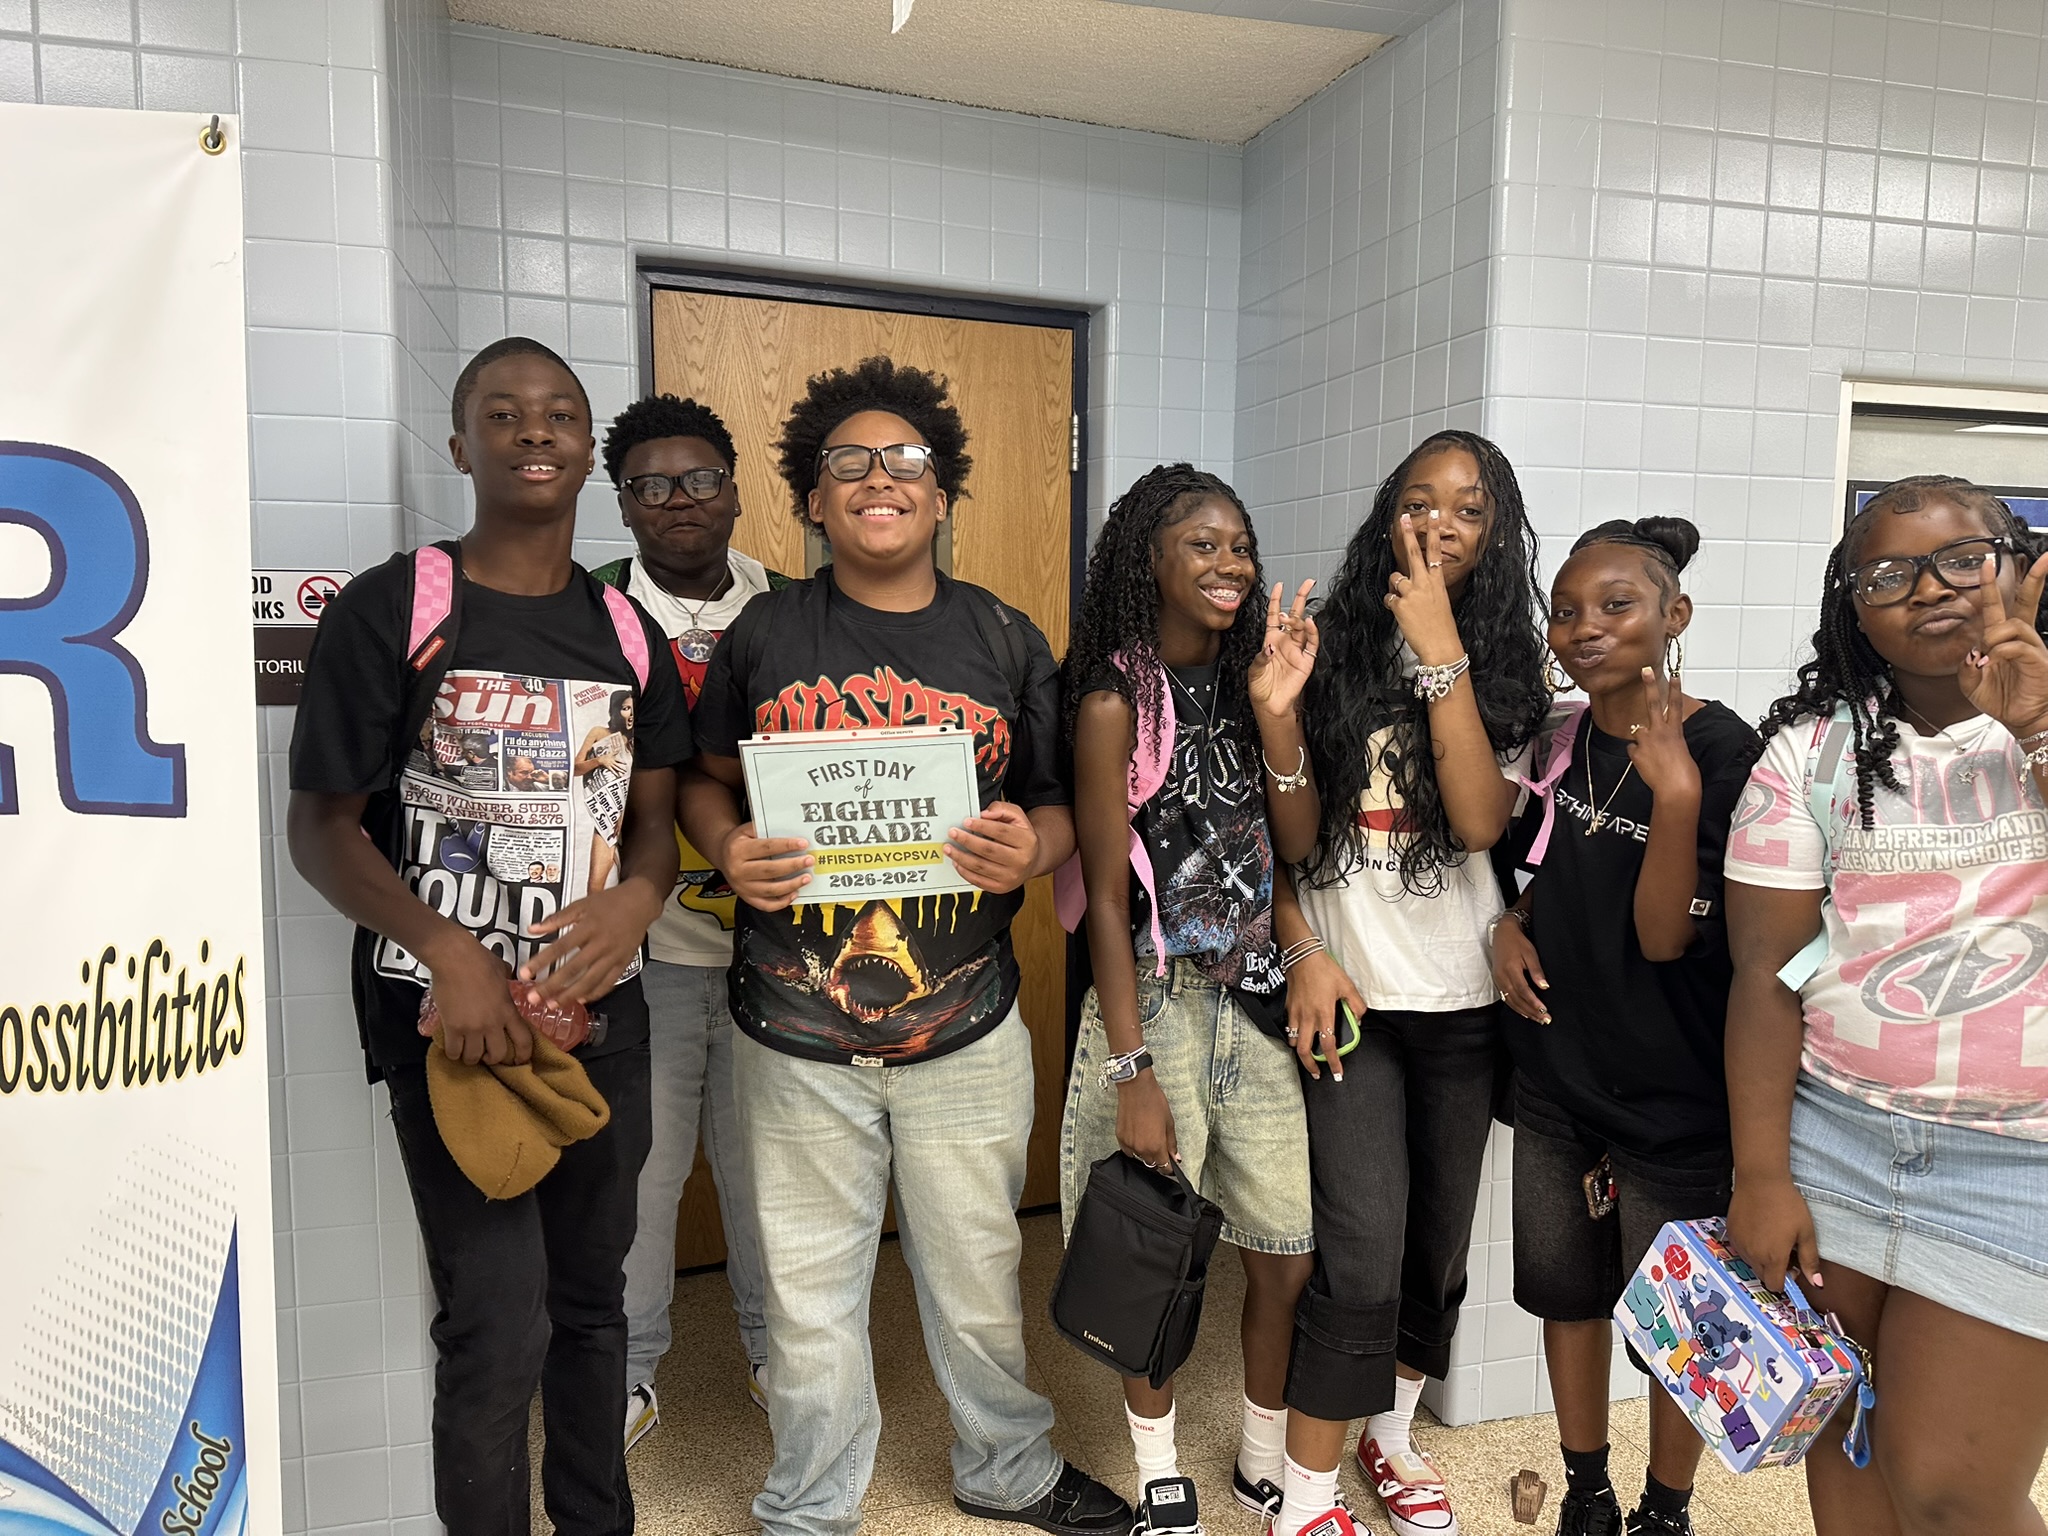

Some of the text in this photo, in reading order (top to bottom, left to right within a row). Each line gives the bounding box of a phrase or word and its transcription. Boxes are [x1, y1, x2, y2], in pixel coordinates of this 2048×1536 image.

[476, 679, 511, 691] THE
[573, 684, 602, 700] PICTURE
[575, 690, 609, 708] EXCLUSIVE
[434, 740, 460, 755] HATE
[504, 737, 567, 748] I'll do anything
[507, 747, 567, 758] to help Gazza
[807, 760, 916, 787] FIRST DAY
[608, 783, 624, 813] Flanag
[854, 778, 873, 798] of
[405, 790, 423, 803] BY
[493, 813, 524, 825] FOR
[528, 813, 564, 825] £375
[447, 794, 514, 814] WINNER
[518, 802, 560, 814] SUED
[586, 796, 608, 831] The Sun
[596, 791, 613, 813] signs
[800, 797, 938, 823] EIGHTH
[405, 807, 446, 865] IT
[814, 821, 932, 846] GRADE
[1606, 816, 1650, 843] APE
[1893, 825, 1995, 851] FREEDOM
[1997, 812, 2048, 839] AND
[818, 850, 940, 865] #FIRSTDAYCPSVA
[1863, 850, 1895, 872] MY
[1899, 848, 1952, 872] OWN
[1956, 837, 2048, 868] CHOICES
[829, 870, 928, 888] 2026-2027
[163, 1421, 231, 1536] School
